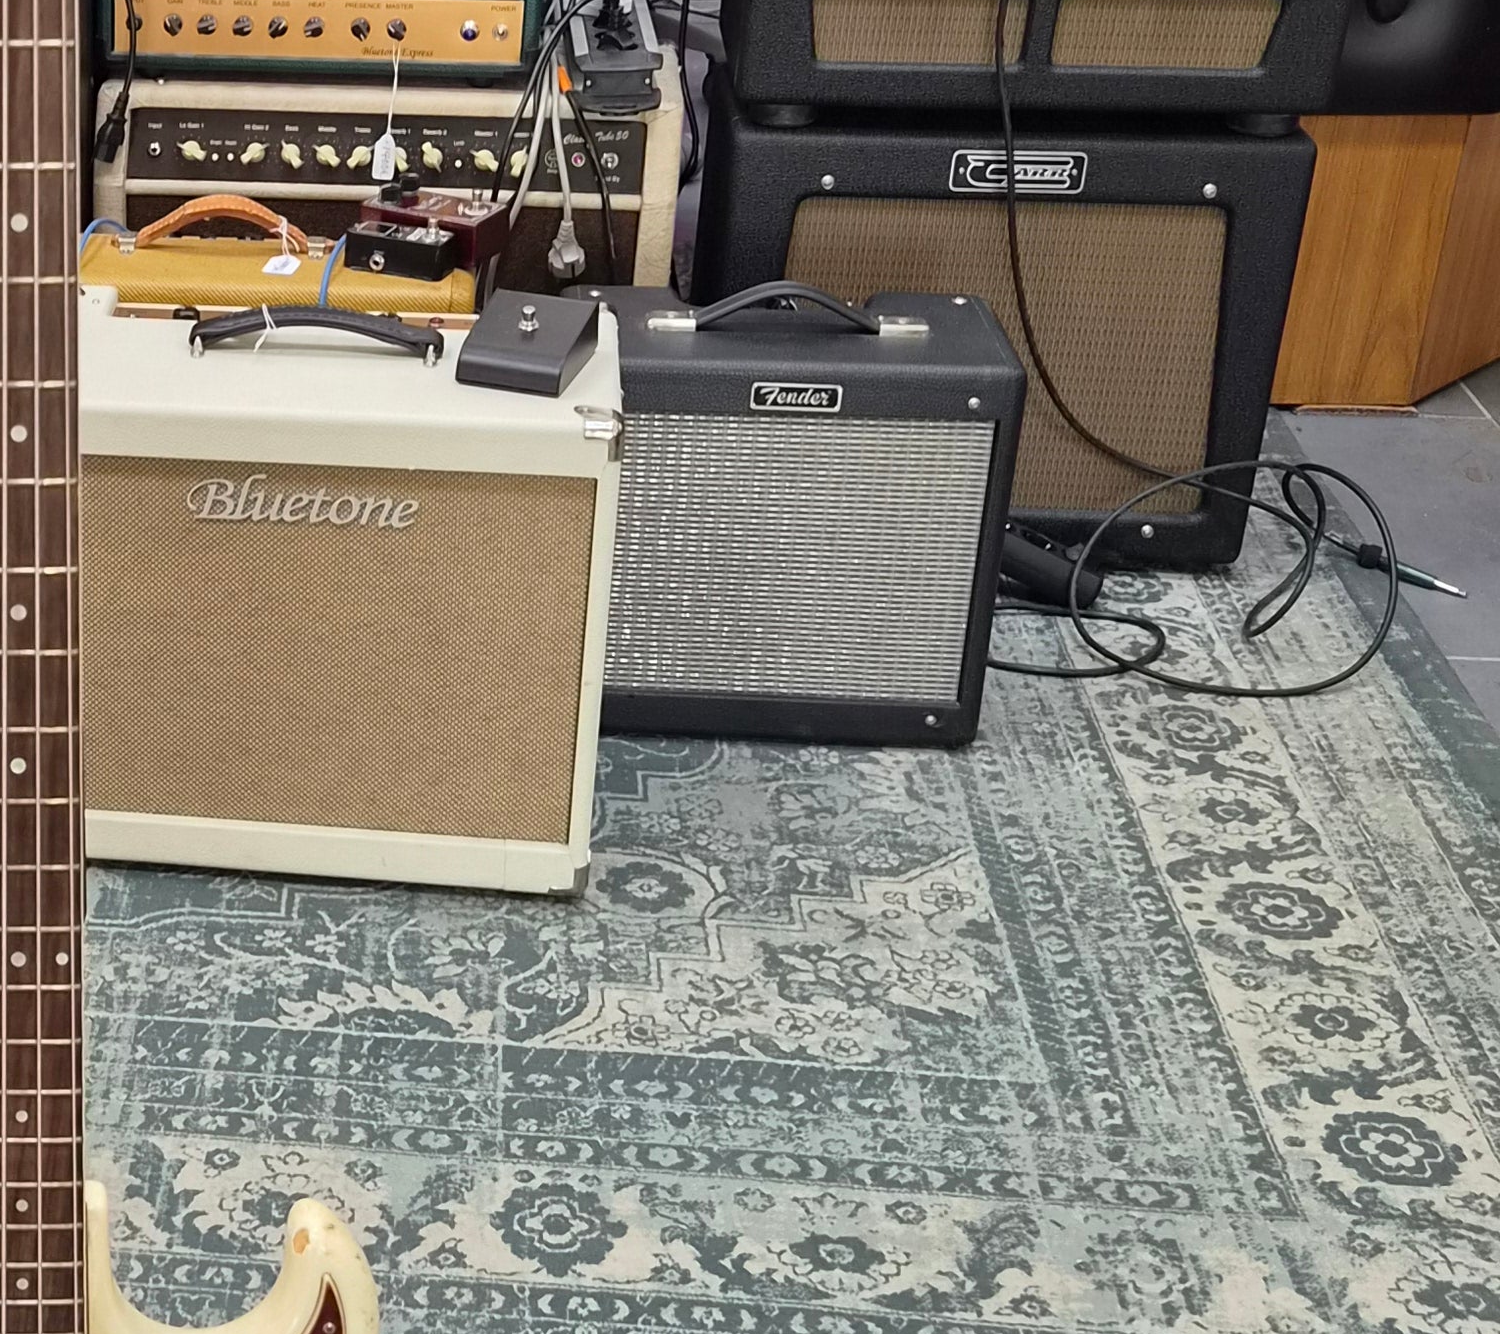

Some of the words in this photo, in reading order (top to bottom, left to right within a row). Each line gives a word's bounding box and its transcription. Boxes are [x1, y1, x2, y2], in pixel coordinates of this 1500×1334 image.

[232, 0, 258, 7] MIDDLE
[271, 0, 291, 8] BASS
[344, 2, 381, 10] PRESENCE
[401, 47, 434, 60] Express
[760, 387, 829, 406] Fender
[187, 473, 419, 528] Bluetone
